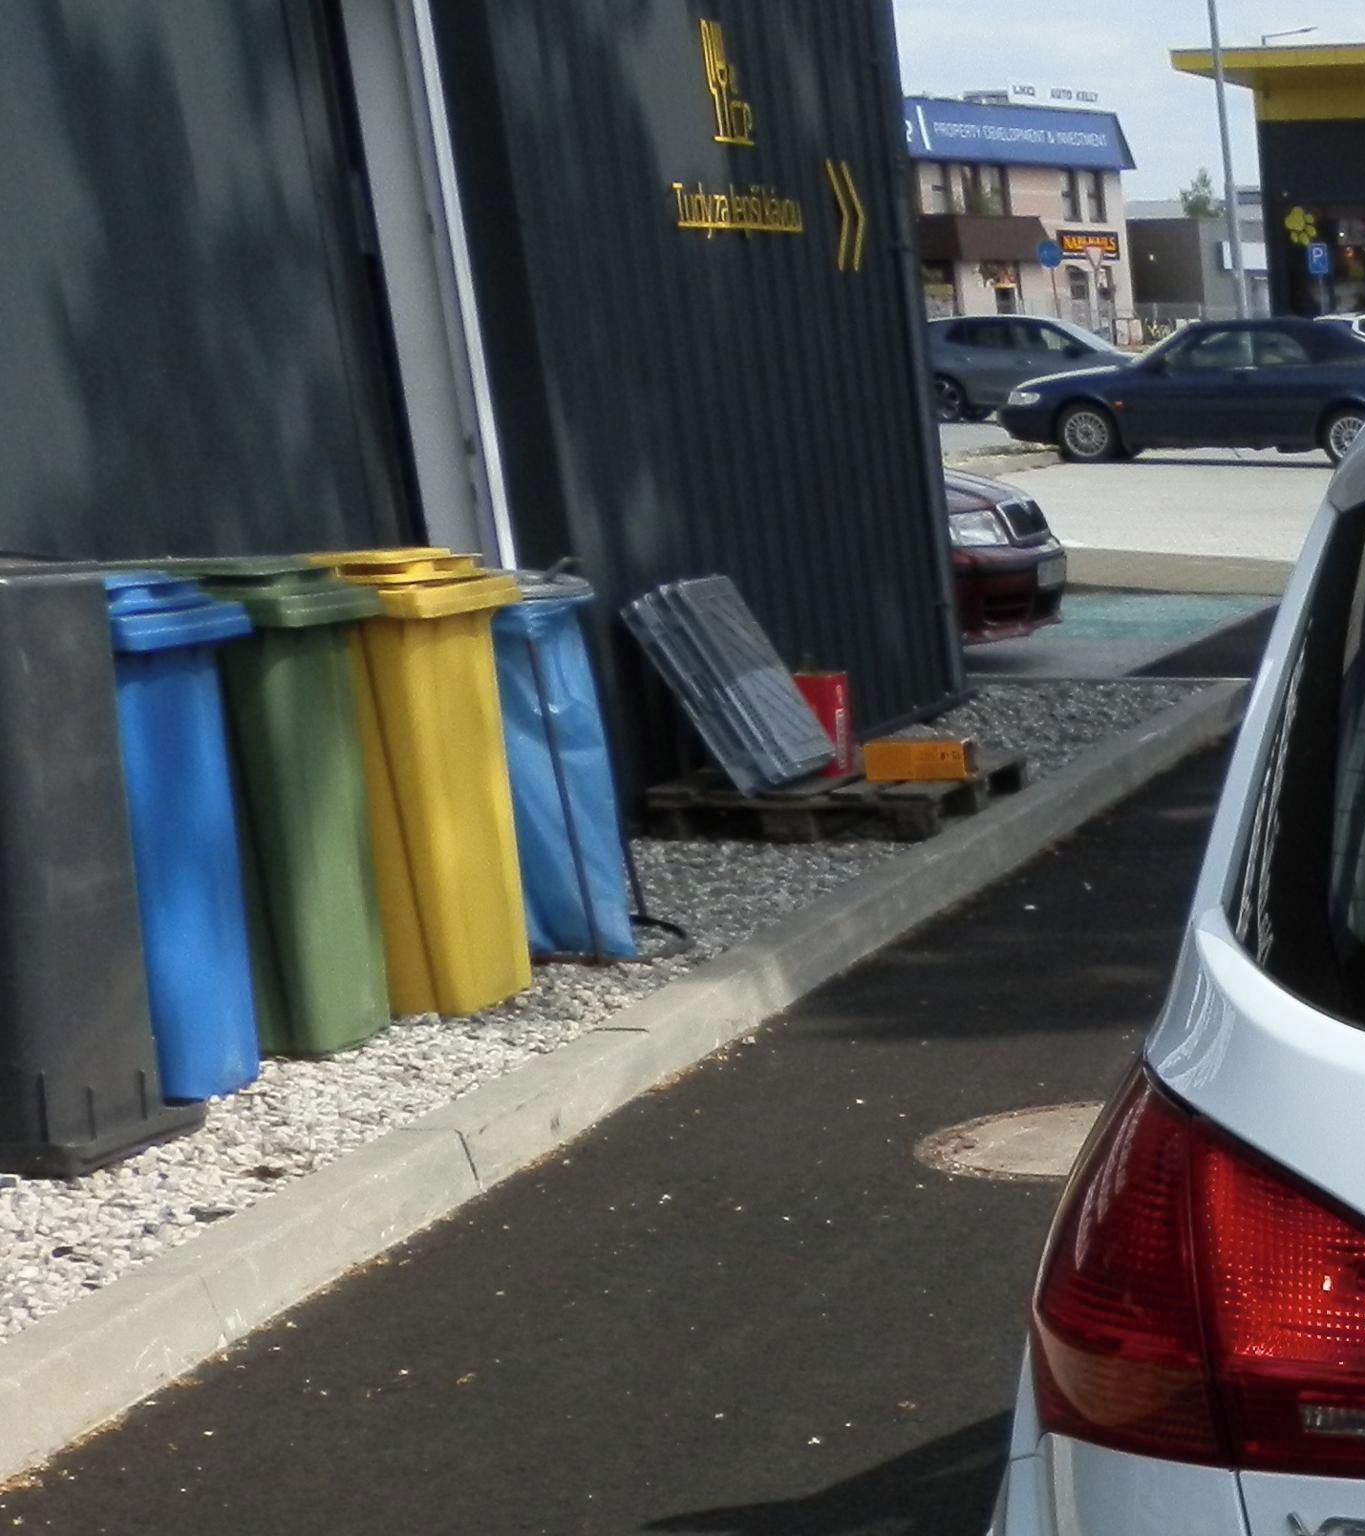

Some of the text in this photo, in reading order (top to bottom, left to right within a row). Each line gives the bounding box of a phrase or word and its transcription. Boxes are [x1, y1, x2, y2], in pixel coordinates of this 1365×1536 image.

[1050, 88, 1072, 101] AUTO
[933, 121, 982, 139] PROPERTY
[982, 125, 1046, 144] DEVELOPMENT
[1056, 131, 1109, 147] INVESTMENT
[1312, 246, 1324, 263] P
